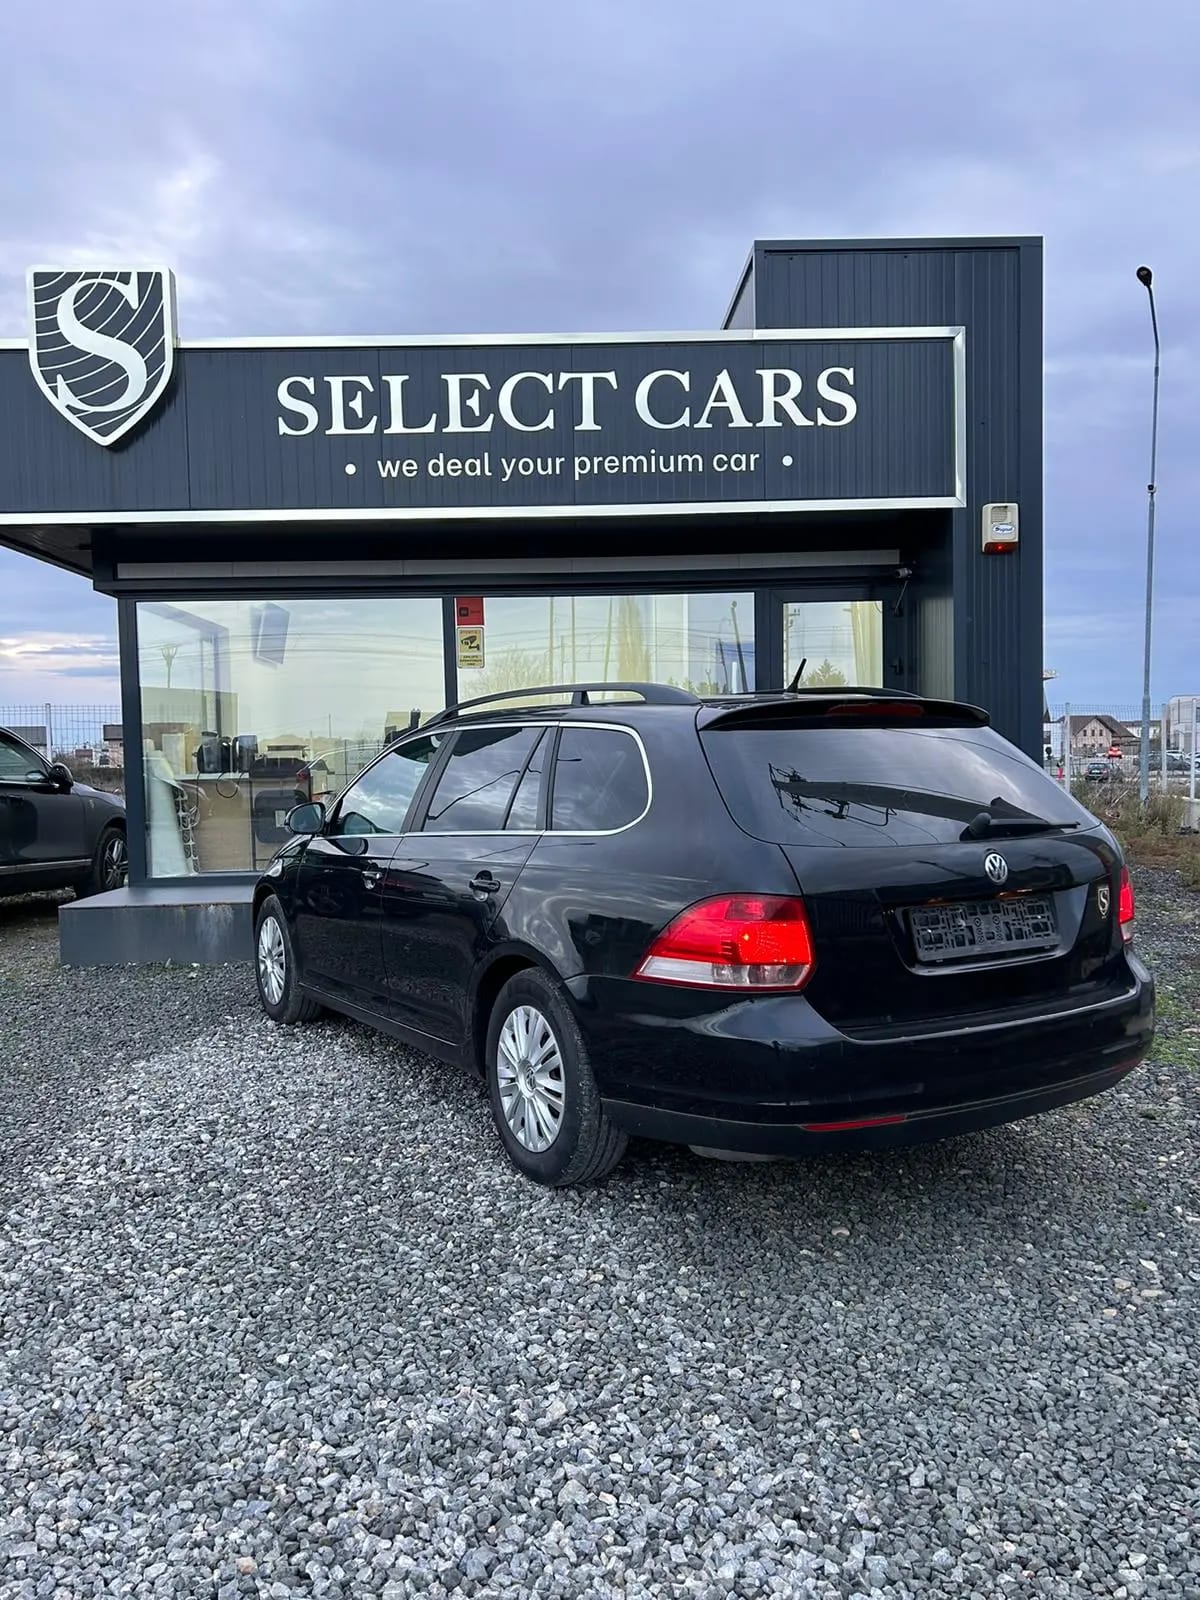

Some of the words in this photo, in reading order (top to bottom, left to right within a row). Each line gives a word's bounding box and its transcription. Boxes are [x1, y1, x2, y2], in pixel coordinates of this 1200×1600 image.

[56, 273, 148, 413] S
[277, 370, 618, 436] SELECT
[634, 366, 857, 430] CARS
[376, 459, 418, 478] we
[427, 451, 493, 477] deal
[500, 456, 566, 482] your
[574, 448, 703, 481] premium
[712, 453, 760, 472] car
